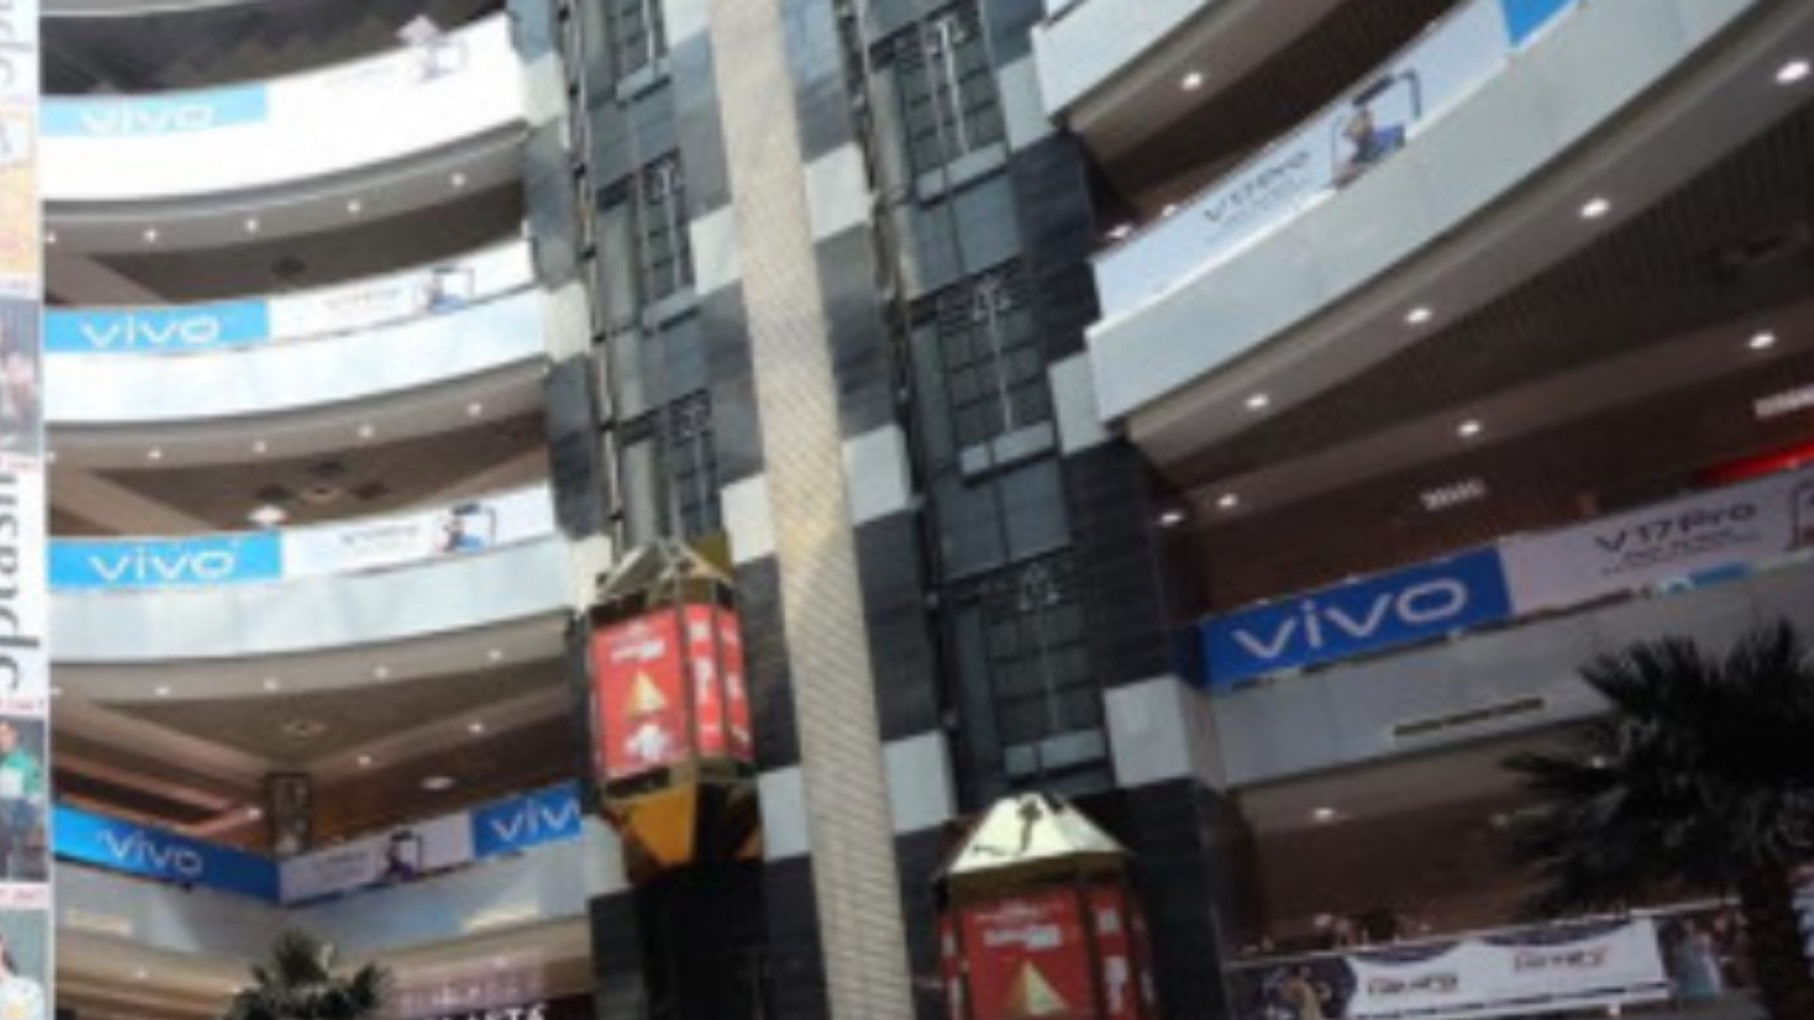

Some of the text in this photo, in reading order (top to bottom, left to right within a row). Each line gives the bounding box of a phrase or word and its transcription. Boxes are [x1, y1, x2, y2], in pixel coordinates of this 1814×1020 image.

[79, 98, 215, 135] vivo
[81, 312, 220, 348] vivo
[90, 544, 236, 583] vivo
[1231, 577, 1469, 660] vivo
[489, 797, 581, 841] viv
[97, 829, 204, 878] vivo
